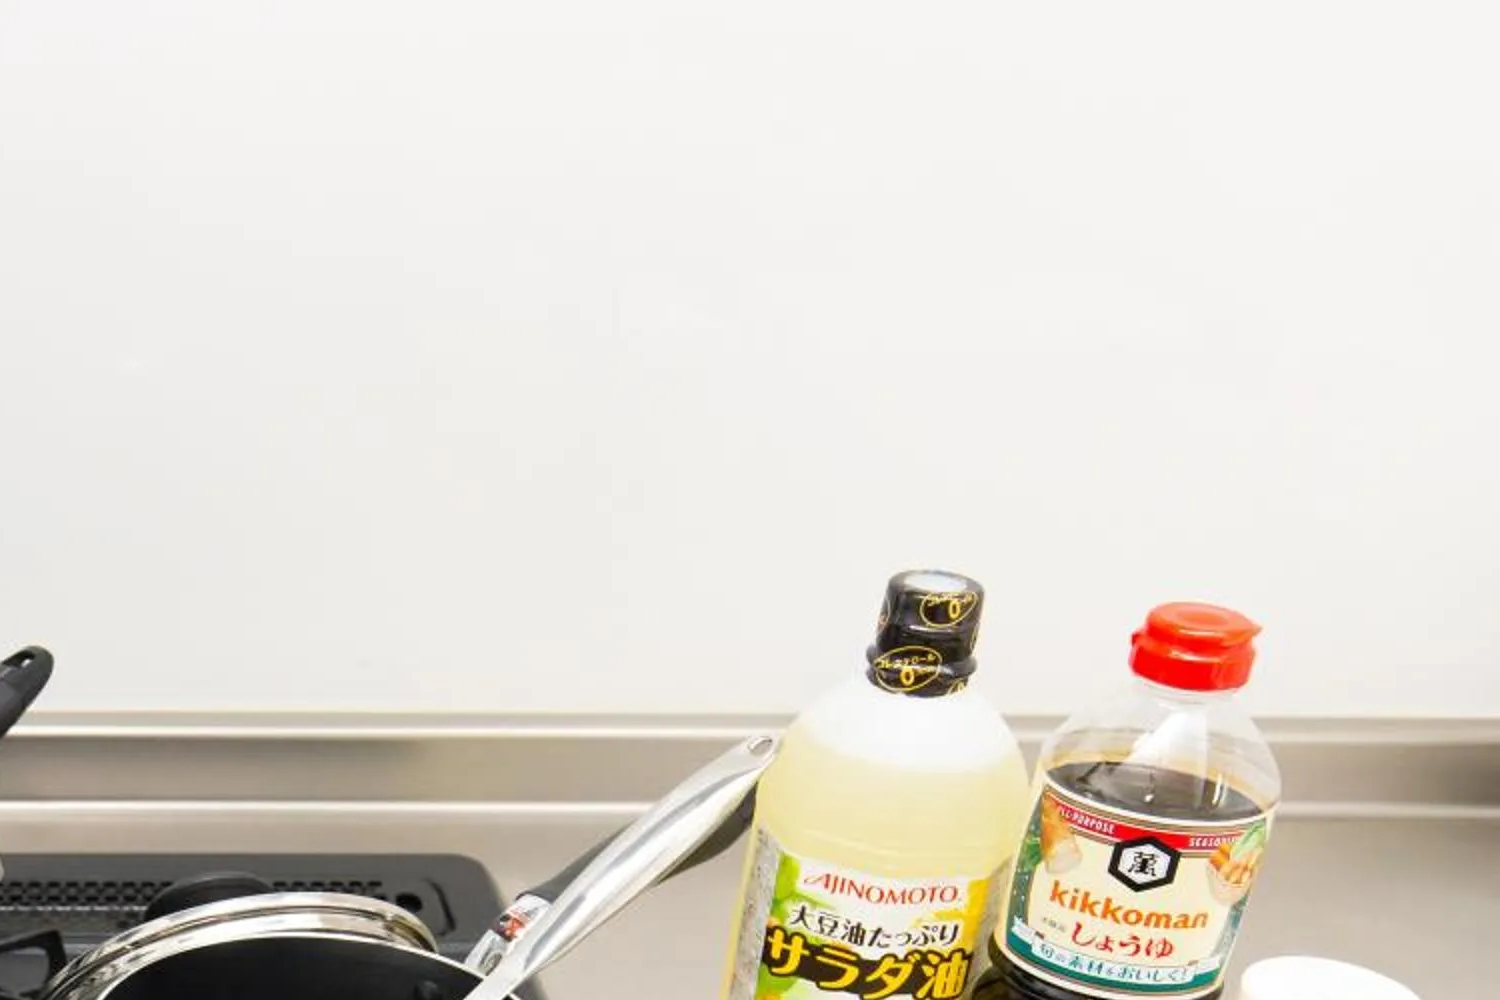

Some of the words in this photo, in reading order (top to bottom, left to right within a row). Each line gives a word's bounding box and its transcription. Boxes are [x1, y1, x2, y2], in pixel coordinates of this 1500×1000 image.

[804, 872, 958, 905] AJINOMOTO
[1049, 879, 1209, 930] kikkoman
[789, 905, 959, 948] 大豆油たっぷり
[1071, 922, 1176, 960] しょうゆ
